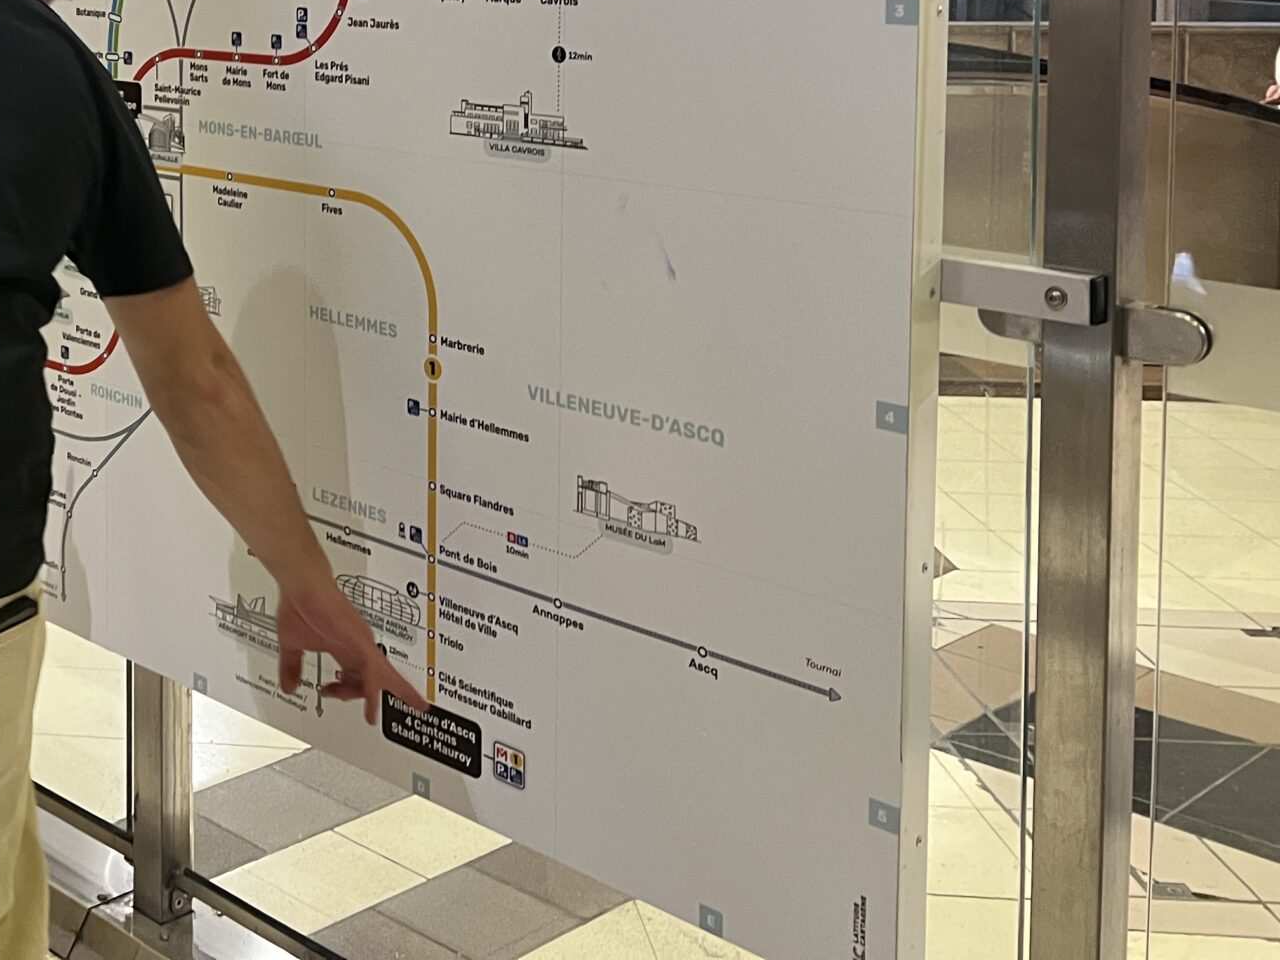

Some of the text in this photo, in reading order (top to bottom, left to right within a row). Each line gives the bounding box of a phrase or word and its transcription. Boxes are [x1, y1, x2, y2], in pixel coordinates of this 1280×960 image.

[76, 8, 106, 19] Botanique
[568, 52, 593, 61] 12min
[154, 83, 201, 97] Saint-Maurice
[198, 119, 322, 148] MONS-EN-BARŒUL
[489, 142, 545, 157] VILLA CAVROIS
[309, 304, 398, 338] HELLEMMES
[440, 335, 485, 355] Marbrerie
[427, 360, 437, 376] 1
[91, 383, 143, 409] RONCHIN
[440, 409, 529, 442] Mairie d'Hellemmes
[527, 383, 726, 448] VILLENEUVE-D'ASCQ
[312, 486, 387, 524] LEZENNES
[440, 484, 514, 517] Square Flandres
[326, 531, 371, 556] Hellemmes
[605, 523, 633, 539] MUSÉE
[634, 531, 647, 543] DU
[506, 545, 529, 560] 10min
[439, 595, 519, 636] Villeneuve d'Ascq
[532, 604, 584, 631] Annappes
[439, 633, 464, 652] Triolo
[688, 657, 719, 680] Ascq
[804, 657, 842, 677] Tournai
[439, 670, 514, 709] Cité Scientifique
[388, 694, 476, 744] Villeneuve d'Ascq
[439, 683, 532, 730] Professeur Gabillard
[405, 715, 457, 747] 4 Cantons
[391, 722, 472, 767] Stade P. Mauroy
